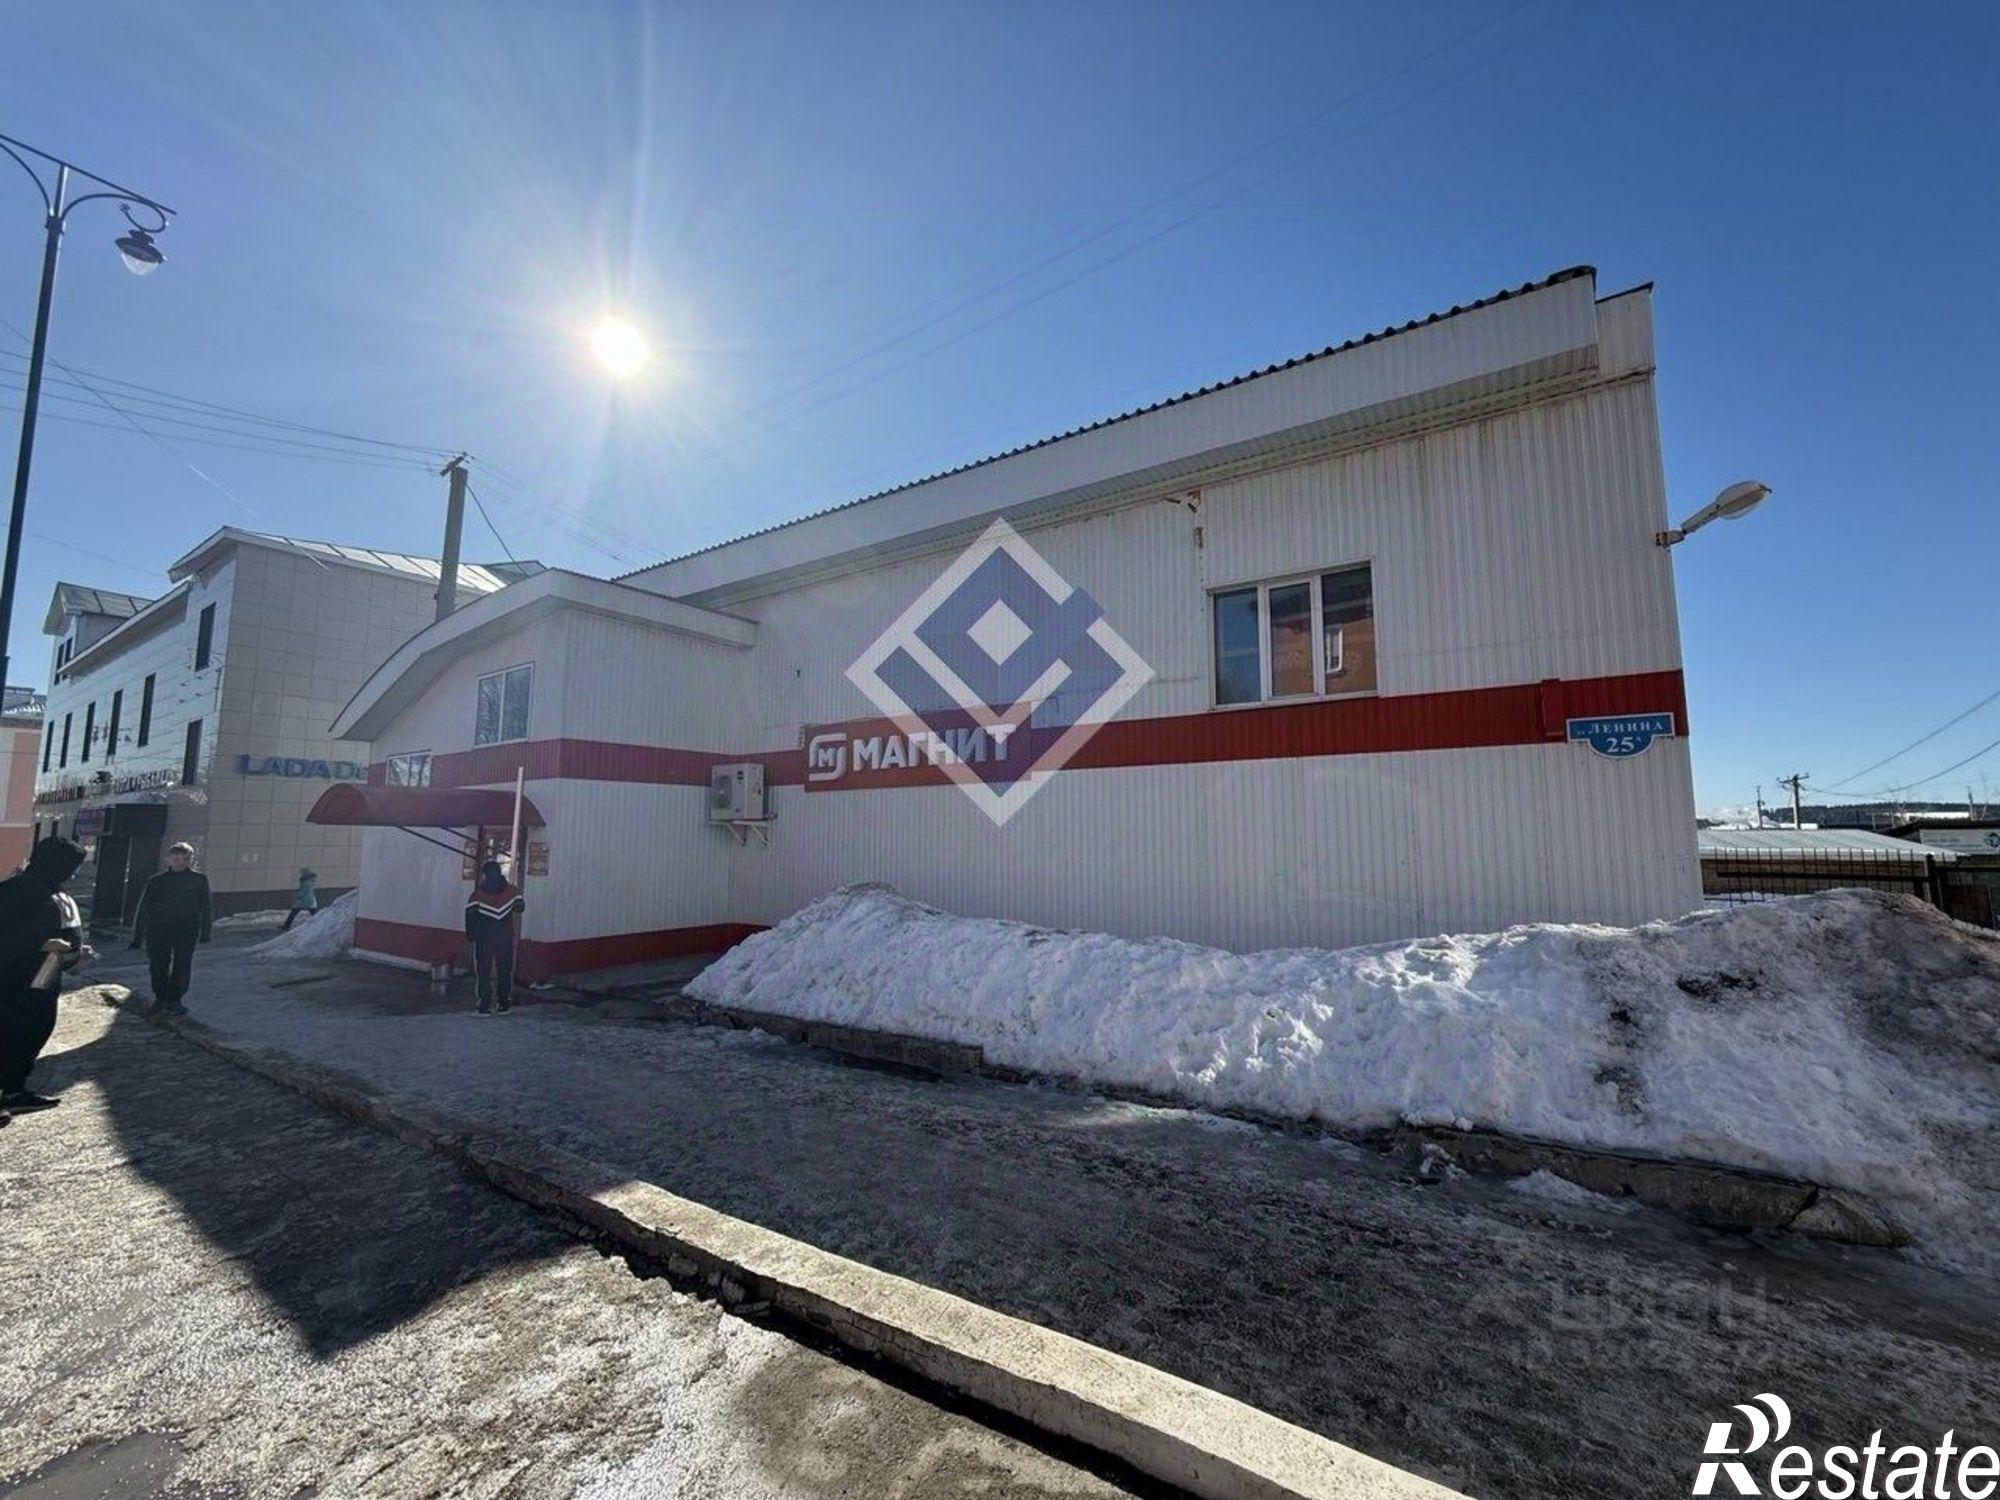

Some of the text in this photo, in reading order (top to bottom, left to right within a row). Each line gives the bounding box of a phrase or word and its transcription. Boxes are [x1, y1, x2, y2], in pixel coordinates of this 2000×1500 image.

[1588, 722, 1663, 734] ЛЕНИНА
[852, 723, 1016, 771] МАГНИТ
[239, 754, 332, 779] LADA
